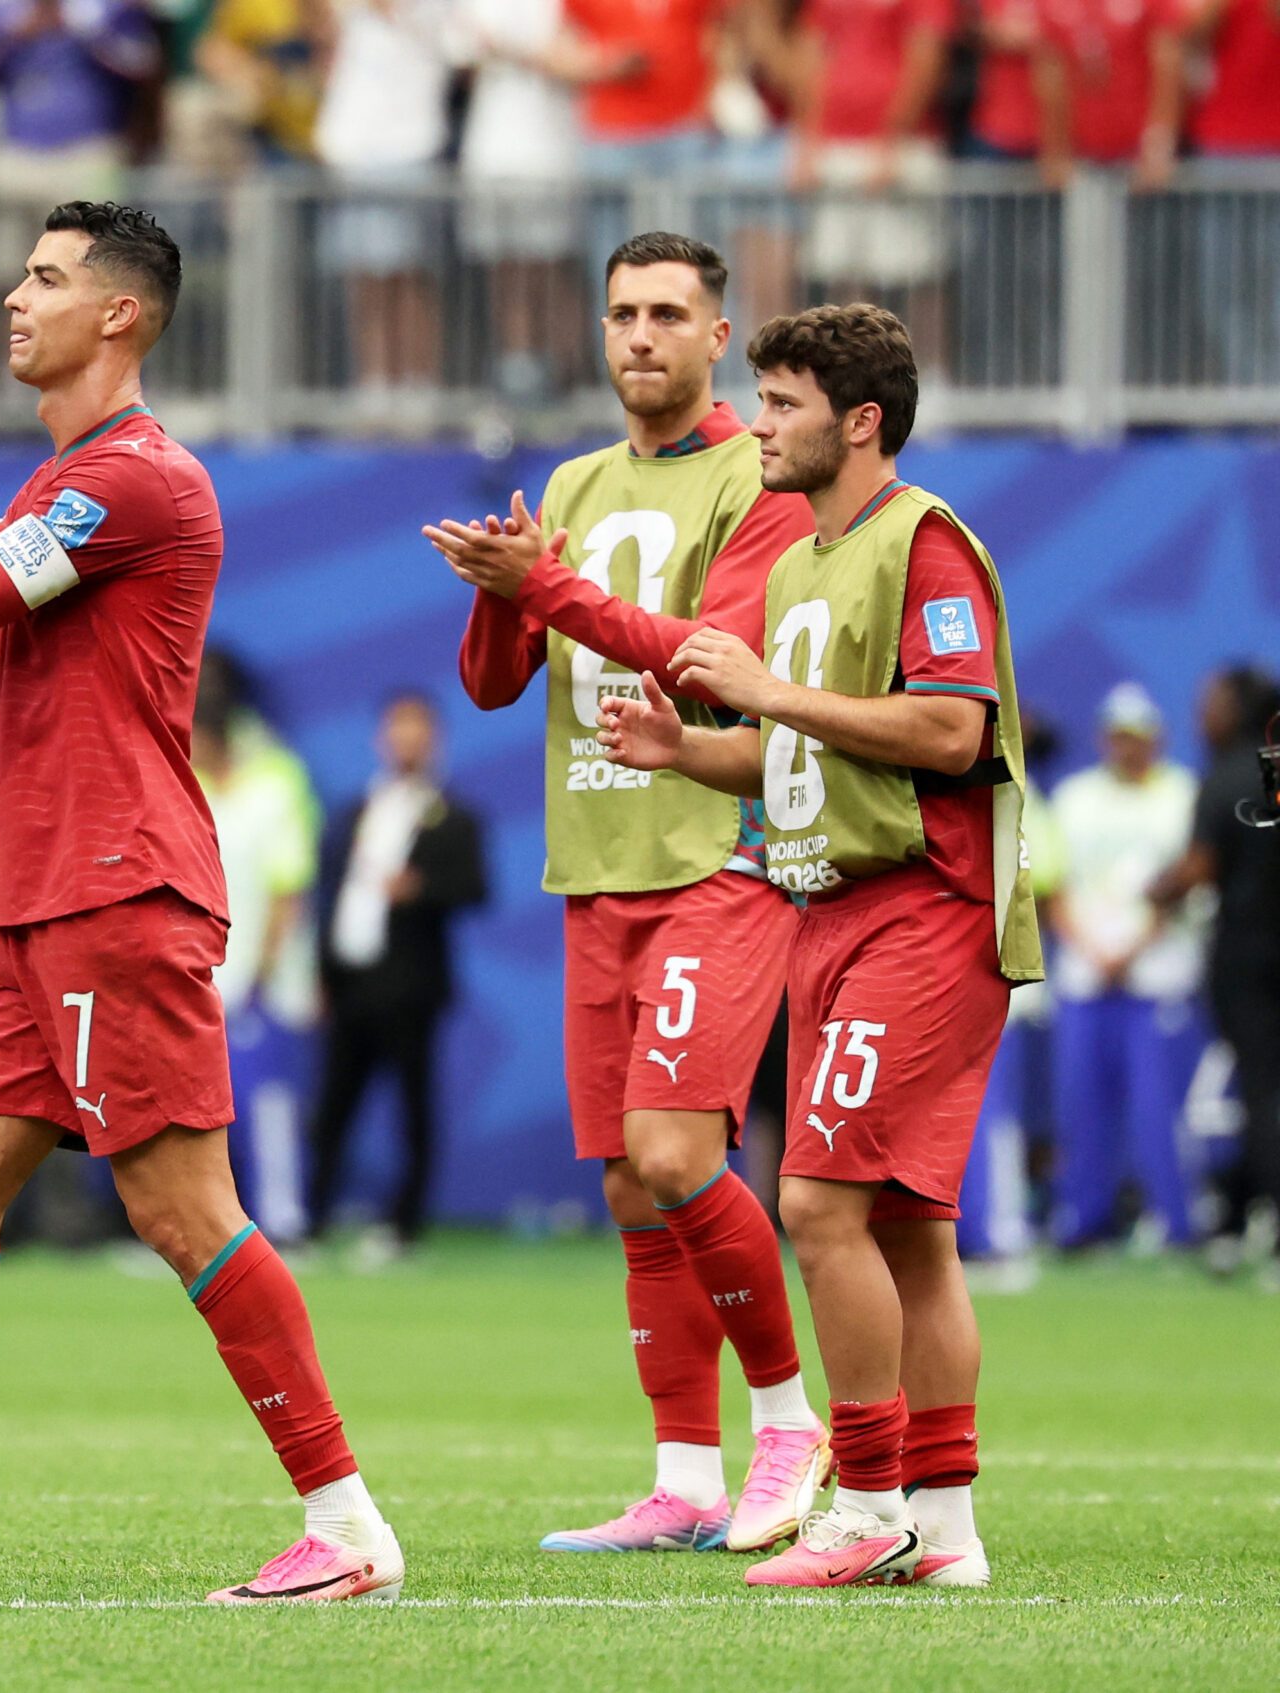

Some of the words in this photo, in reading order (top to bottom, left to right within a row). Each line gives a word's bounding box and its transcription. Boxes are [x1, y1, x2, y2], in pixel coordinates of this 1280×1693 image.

[12, 524, 47, 566] UNITES
[25, 517, 54, 558] FOOTBALL
[9, 544, 38, 578] World
[943, 630, 967, 642] PEACE
[807, 834, 829, 857] CUP
[768, 859, 842, 893] 2026
[655, 956, 701, 1039] 5
[62, 990, 95, 1088] 7
[810, 1020, 887, 1109] 15
